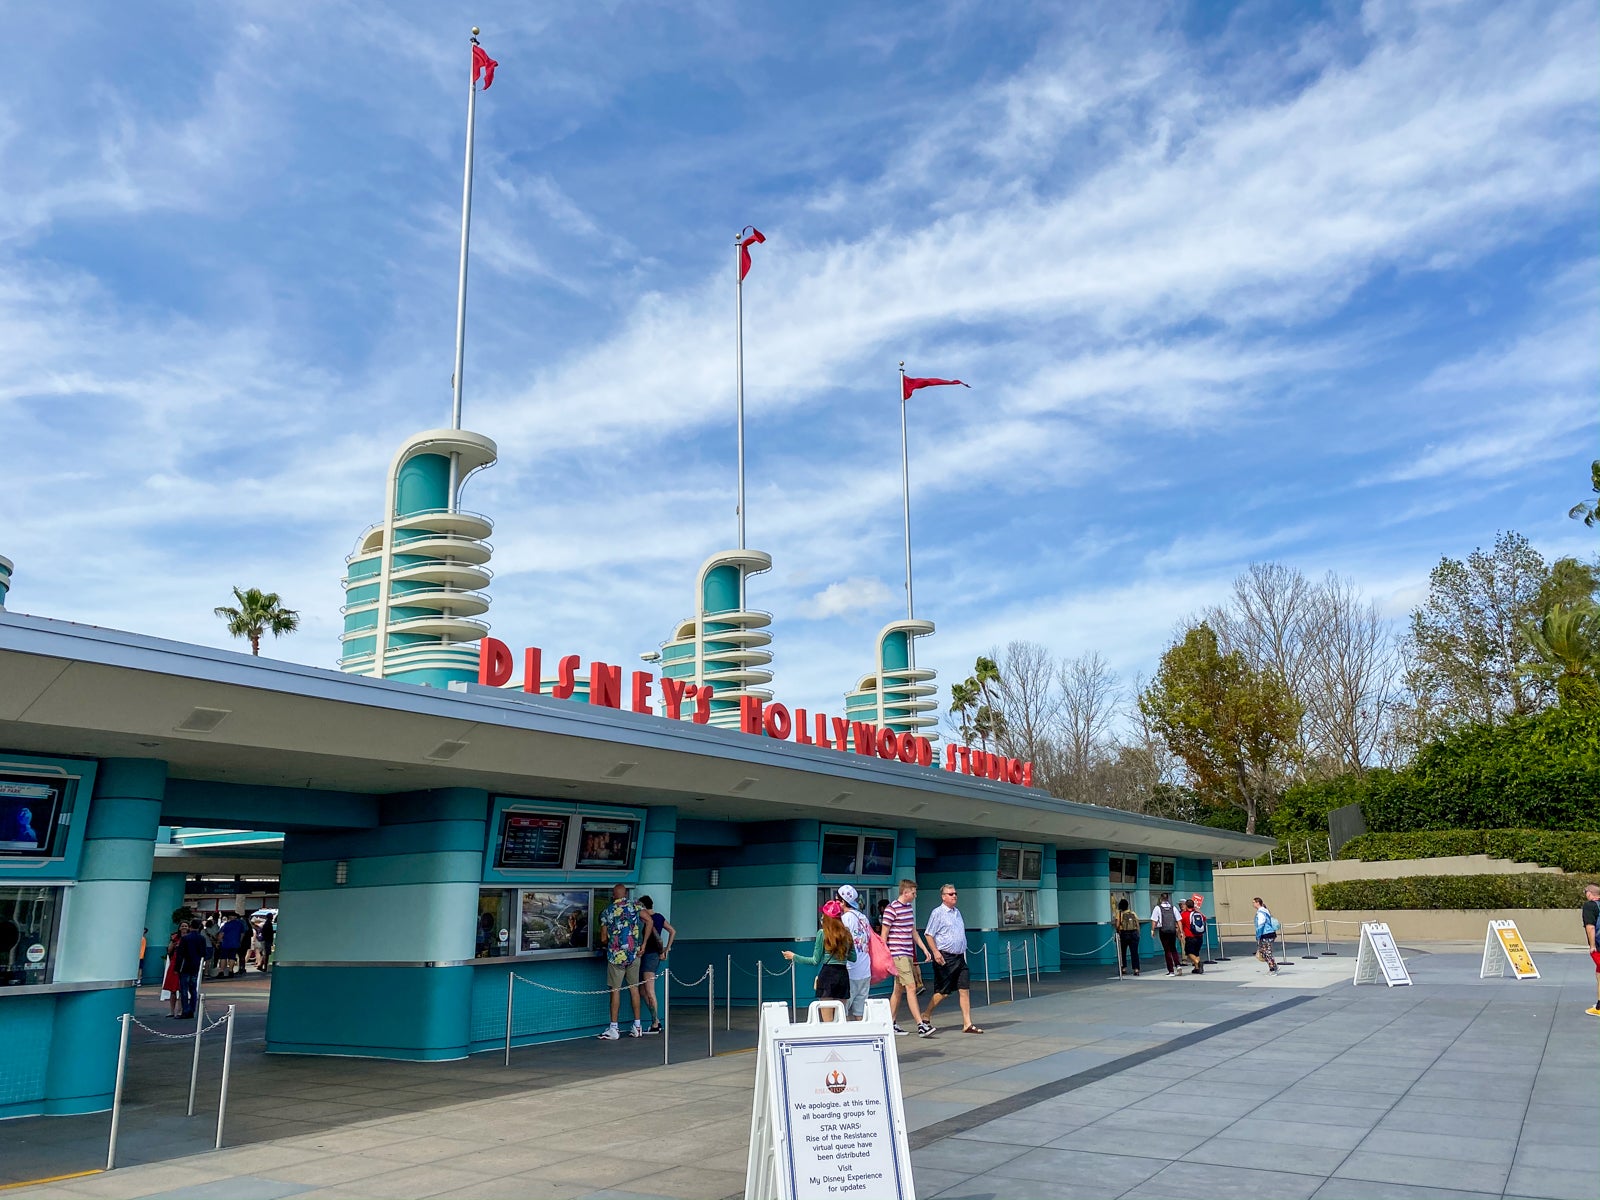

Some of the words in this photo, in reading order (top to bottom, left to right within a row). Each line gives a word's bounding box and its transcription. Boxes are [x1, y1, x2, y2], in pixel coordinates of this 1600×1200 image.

[478, 637, 713, 724] DISNEY'S
[740, 695, 933, 767] HOLLYWOOD
[946, 743, 1034, 787] STUDIOS
[802, 1112, 811, 1120] all
[812, 1111, 841, 1120] boarding
[842, 1110, 865, 1119] groups
[820, 1124, 838, 1132] STAR
[839, 1122, 861, 1131] WARS:
[830, 1133, 842, 1141] the
[843, 1131, 878, 1140] Resistance
[812, 1143, 834, 1152] virtual
[835, 1143, 855, 1151] queue
[817, 1153, 834, 1161] been
[835, 1150, 871, 1160] distributed
[837, 1164, 853, 1172] Visit
[809, 1176, 821, 1186] My
[822, 1175, 846, 1183] Disney
[847, 1172, 883, 1182] Experience
[828, 1185, 838, 1193] for
[839, 1183, 867, 1193] updates
